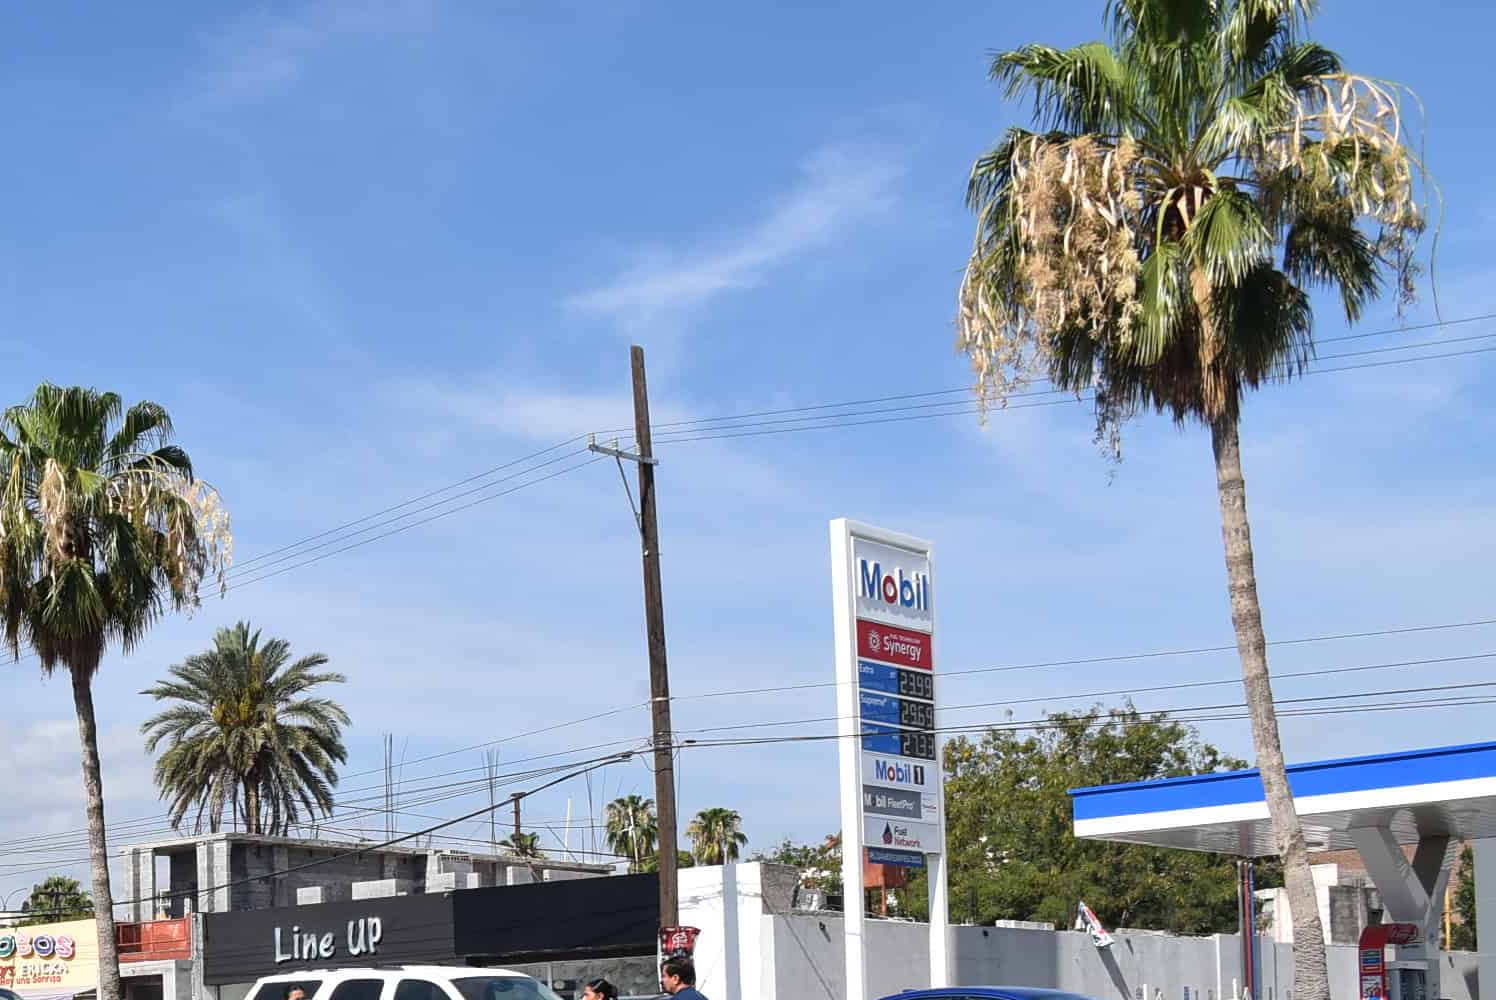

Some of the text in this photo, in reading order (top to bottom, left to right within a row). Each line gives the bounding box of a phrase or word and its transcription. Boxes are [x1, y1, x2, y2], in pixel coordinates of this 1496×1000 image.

[860, 559, 928, 611] Mobil
[883, 636, 921, 662] Synergy
[876, 760, 911, 784] Mobil
[273, 916, 383, 963] Line UP
